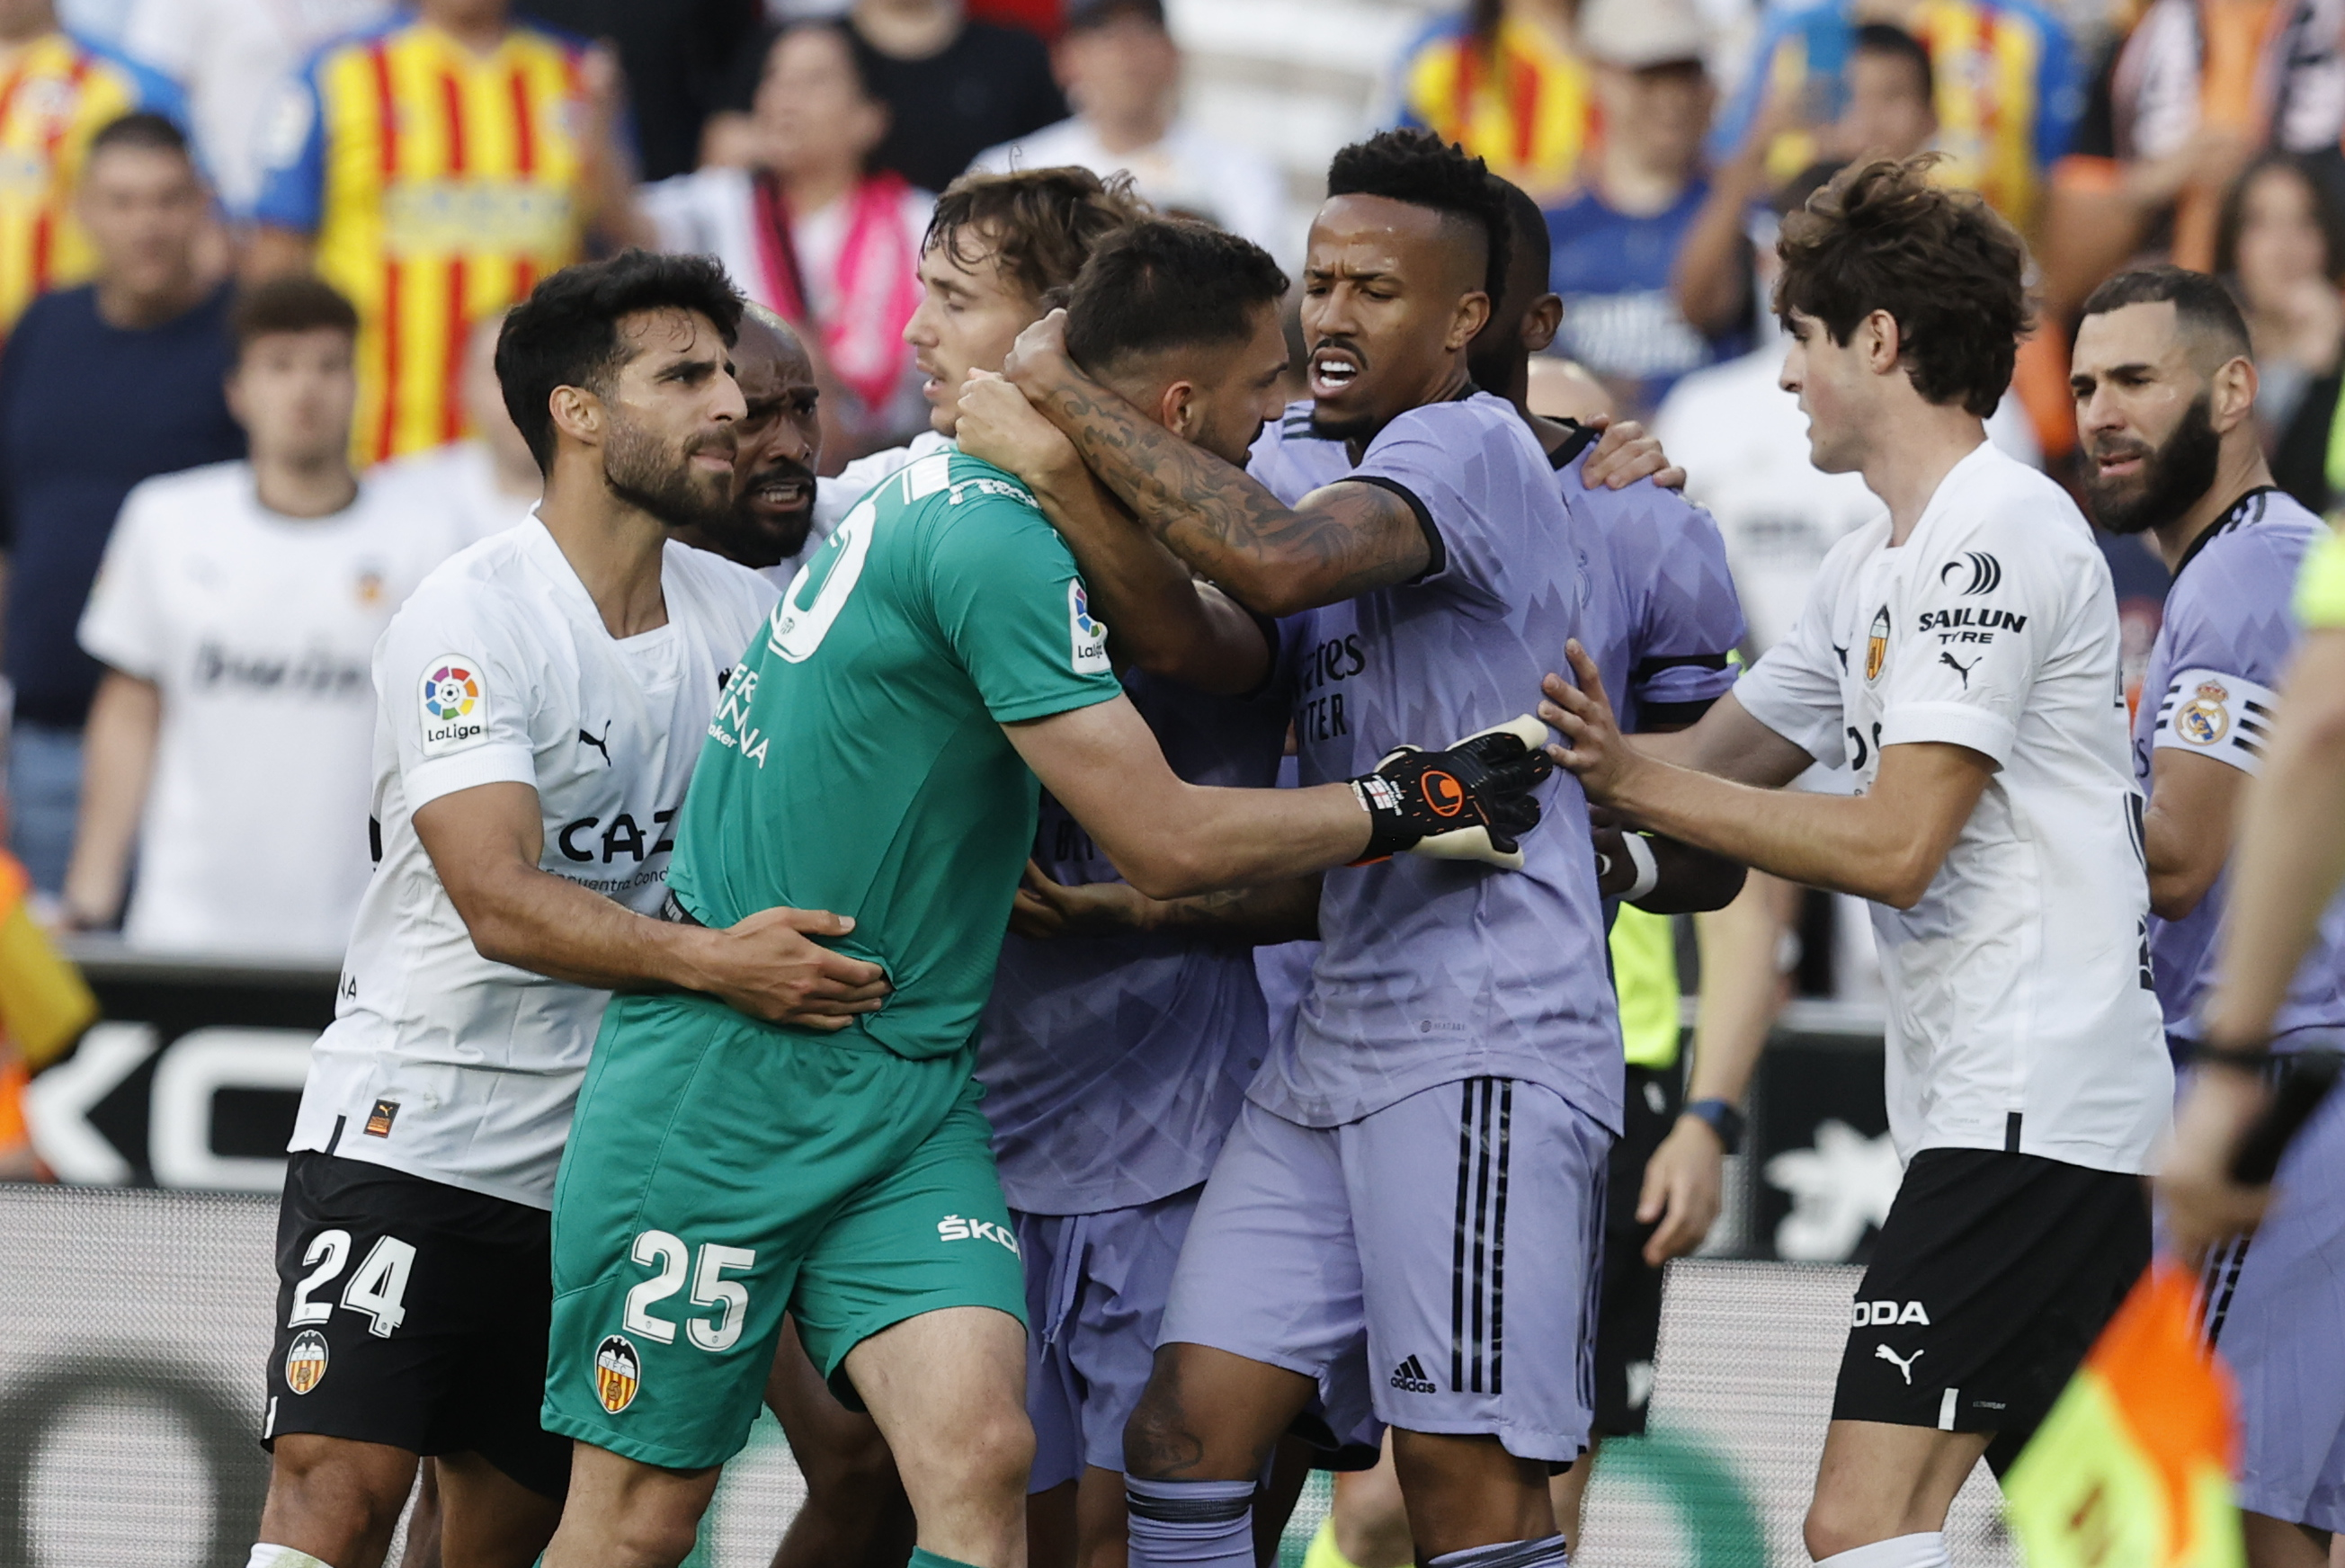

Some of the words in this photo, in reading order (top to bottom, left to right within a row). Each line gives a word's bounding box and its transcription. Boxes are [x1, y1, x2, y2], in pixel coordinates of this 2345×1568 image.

[1918, 607, 2028, 634] SAILUN
[1937, 630, 1995, 646] TYRE
[428, 723, 481, 744] LaLiga
[937, 1214, 1021, 1262] ŠKO
[288, 1229, 418, 1339] 24
[622, 1229, 756, 1352] 25
[1390, 1375, 1437, 1394] adidas
